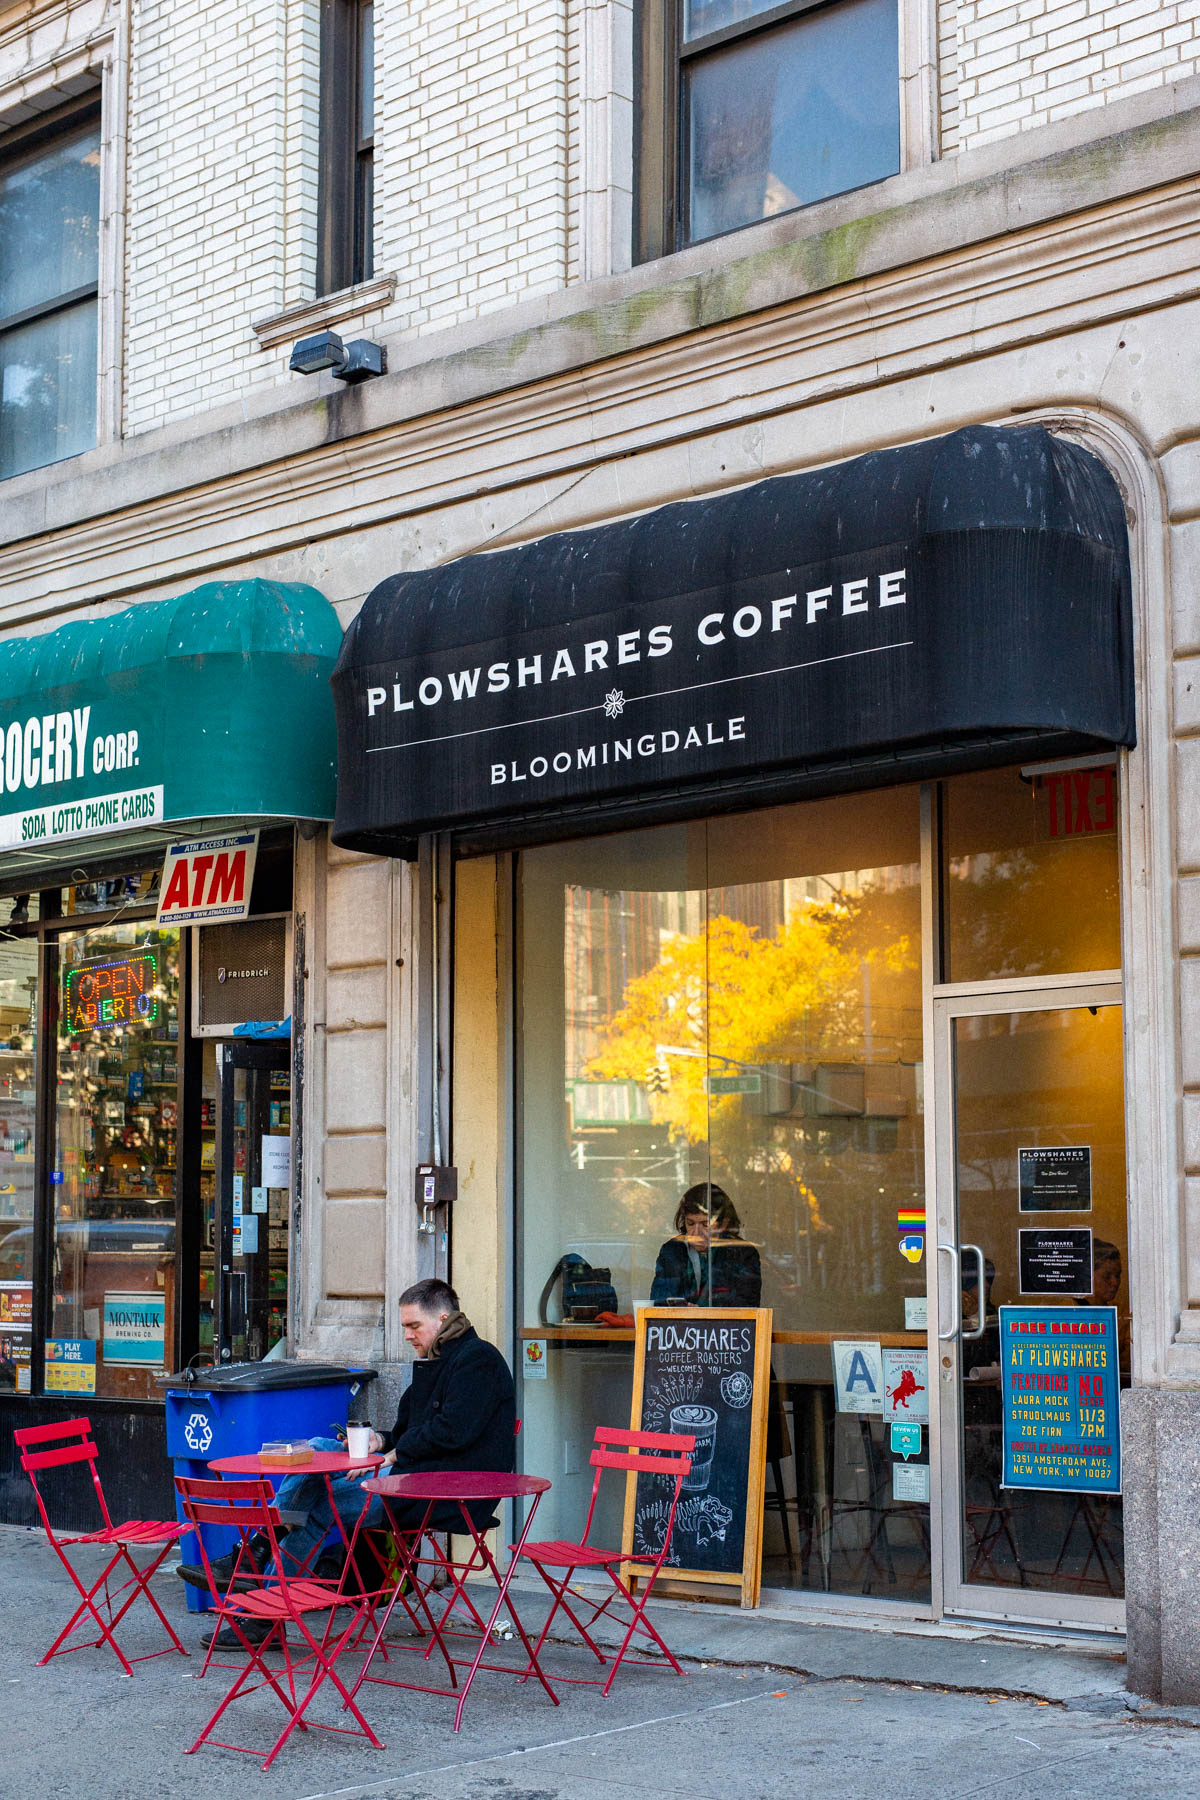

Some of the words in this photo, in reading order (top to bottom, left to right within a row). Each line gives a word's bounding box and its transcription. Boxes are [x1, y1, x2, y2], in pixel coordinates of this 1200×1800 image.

[366, 623, 673, 717] PLOWSHARES
[697, 567, 907, 646] COFFEE
[0, 705, 91, 794] OCERY
[92, 730, 140, 775] CORP.
[490, 715, 746, 785] BLOOMINGDALE
[22, 813, 46, 841] SODA
[52, 805, 83, 835] LOTTO
[85, 799, 119, 829] PHONE
[121, 792, 155, 823] CARDS
[184, 844, 199, 853] ATM
[200, 840, 224, 850] ACCESS
[225, 838, 240, 846] INC.
[161, 850, 246, 911] ATM
[228, 969, 269, 978] FRIEDRICH
[78, 963, 144, 1002] OPEN
[74, 993, 150, 1026] ABIERTO
[109, 1312, 160, 1328] MONTAUK
[1010, 1322, 1046, 1334] FREE
[1050, 1322, 1106, 1335] BREAD!
[64, 1342, 81, 1351] PLAY
[647, 1326, 752, 1353] PLOWSHARES
[64, 1352, 83, 1360] HERE.
[659, 1352, 692, 1363] COFFEE
[696, 1352, 742, 1365] ROASTERS
[1011, 1350, 1024, 1366] AT
[1030, 1350, 1107, 1368] PLOWSHARES
[666, 1365, 703, 1374] WELCOMES
[708, 1366, 722, 1374] YOU
[846, 1350, 876, 1393] A
[1011, 1373, 1069, 1391] FEATURING
[1079, 1376, 1103, 1396] NO
[1012, 1395, 1041, 1405] LAURA
[1044, 1396, 1069, 1406] MOCK
[1079, 1396, 1104, 1407] COVER
[1079, 1409, 1105, 1423] 11/3
[1021, 1426, 1038, 1436] ZOE
[1041, 1426, 1062, 1437] FIRN
[1080, 1424, 1105, 1438] 7PM
[1011, 1441, 1036, 1452] HOSTED
[1039, 1443, 1048, 1452] BY
[1050, 1443, 1080, 1454] GRANITE
[1083, 1445, 1112, 1456] GARDEN
[1033, 1456, 1087, 1466] AMSTERDAM
[1091, 1458, 1111, 1468] AVE.
[1013, 1465, 1033, 1474] NEW
[1037, 1467, 1064, 1477] YORK,
[1068, 1468, 1080, 1477] NY
[1084, 1469, 1112, 1479] 10027
